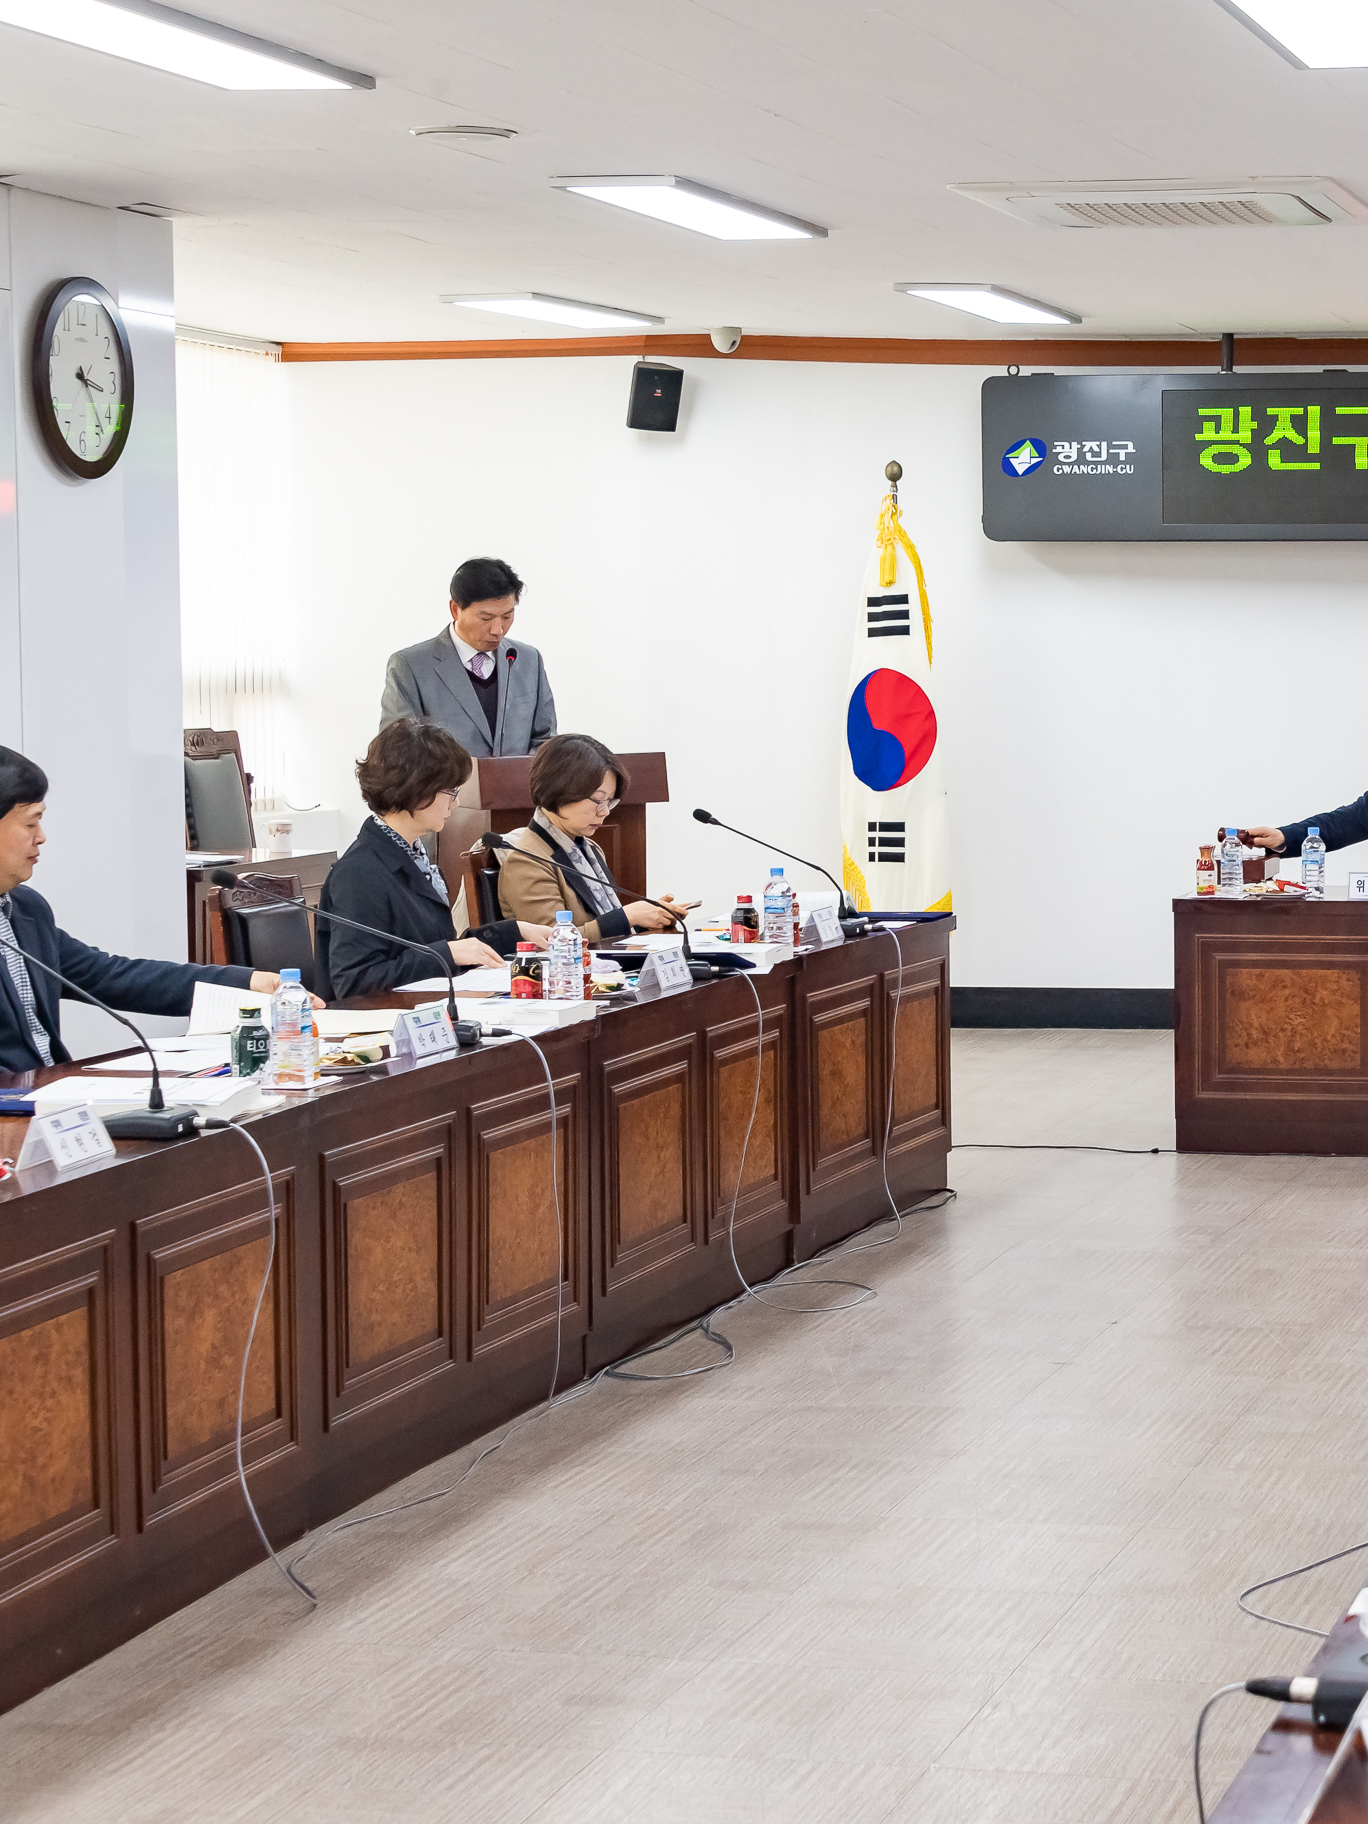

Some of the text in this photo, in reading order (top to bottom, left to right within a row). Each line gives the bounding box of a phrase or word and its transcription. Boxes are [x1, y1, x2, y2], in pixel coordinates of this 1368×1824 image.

[76, 303, 87, 327] 12
[104, 336, 111, 360] 2
[109, 371, 117, 395] 3
[104, 403, 112, 425] 4
[79, 430, 87, 454] 6
[95, 424, 102, 448] 5
[1052, 440, 1136, 463] 광진구
[1053, 464, 1134, 475] GWANGJIN-GU
